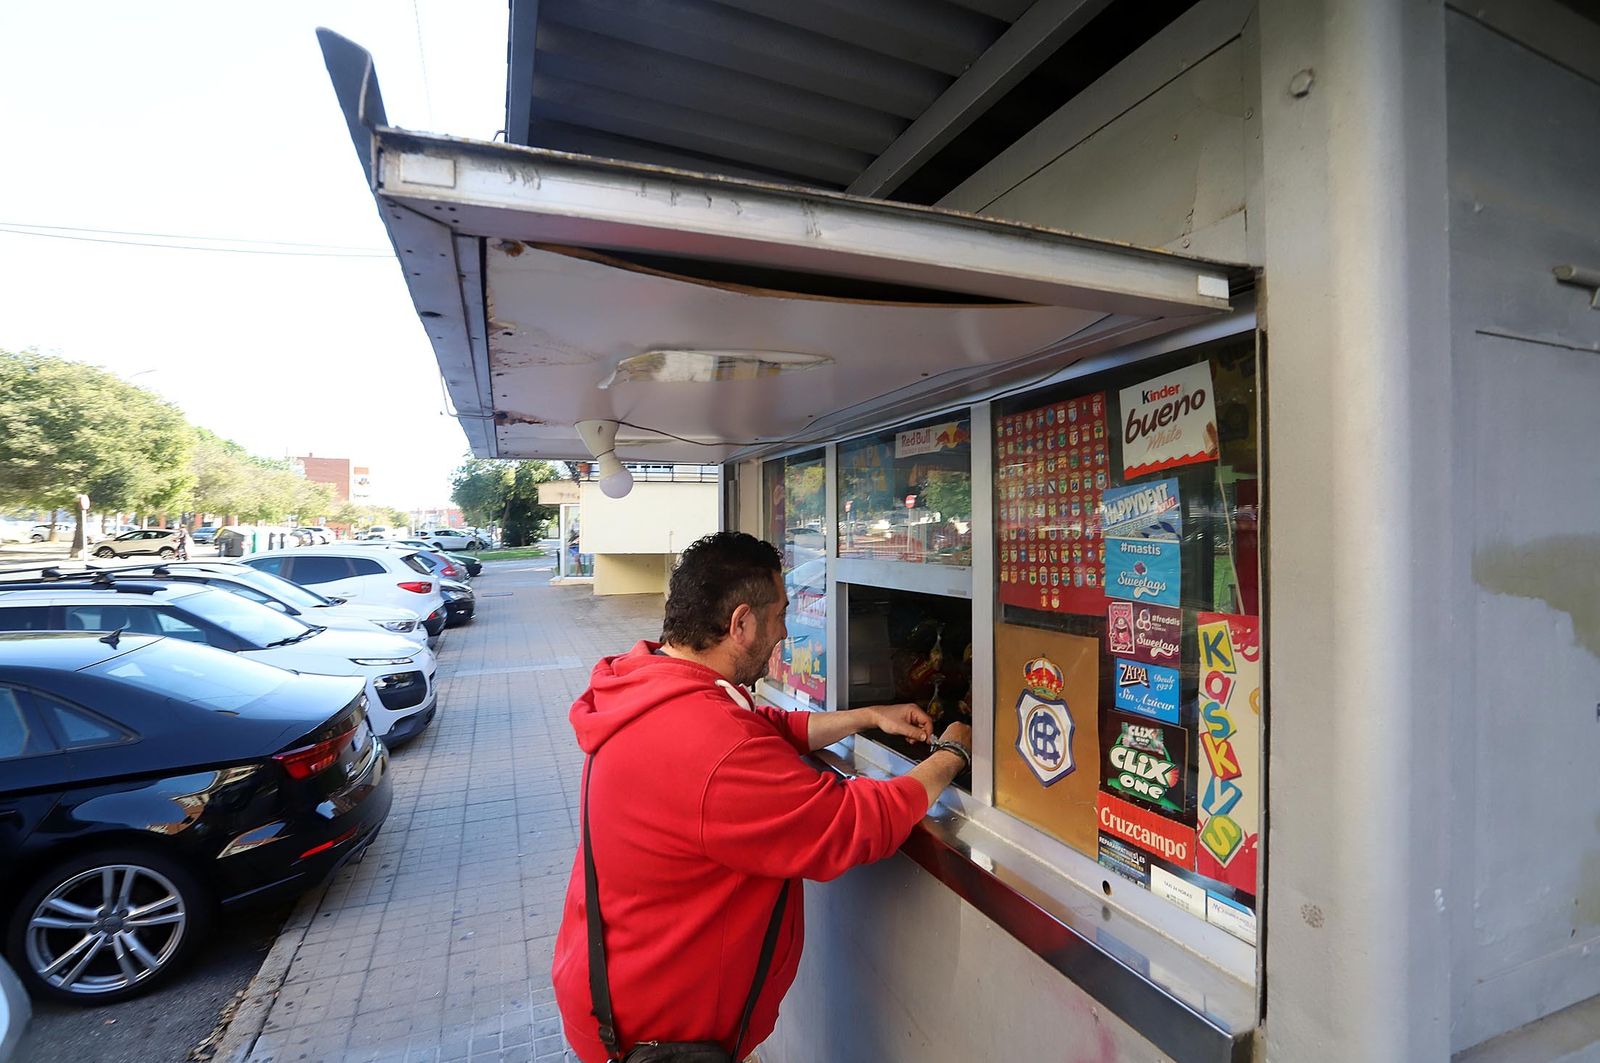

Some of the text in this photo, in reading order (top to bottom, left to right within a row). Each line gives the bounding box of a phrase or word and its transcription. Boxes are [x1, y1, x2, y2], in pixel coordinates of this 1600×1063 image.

[1142, 384, 1180, 404] Kinder
[1125, 389, 1206, 444] bueno
[901, 432, 915, 448] Red
[1104, 483, 1168, 526] HAPPYDENT
[1120, 542, 1161, 555] #mastis
[1118, 688, 1135, 701] Sin
[1100, 805, 1187, 860] Cruzcampo
